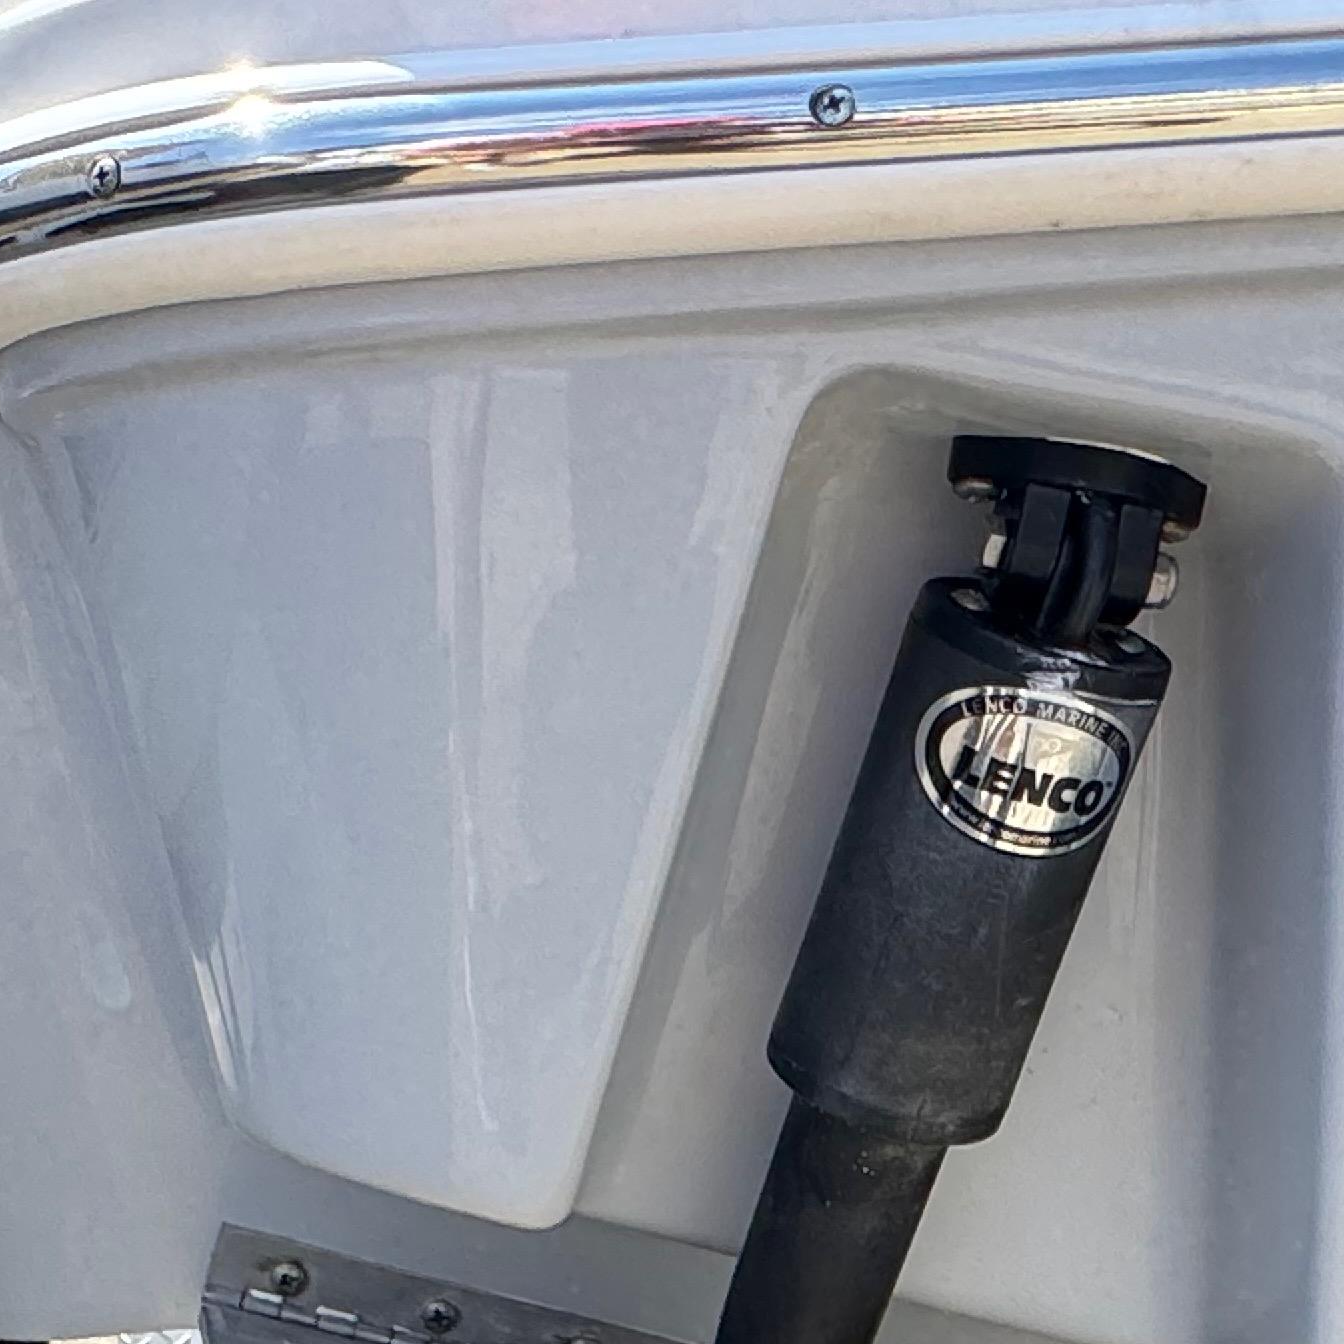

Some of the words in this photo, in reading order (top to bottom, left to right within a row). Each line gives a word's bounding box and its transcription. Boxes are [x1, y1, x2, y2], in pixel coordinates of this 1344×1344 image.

[960, 694, 1028, 717] LENCO
[1035, 701, 1109, 738] MARINE
[951, 744, 1104, 817] LENCO
